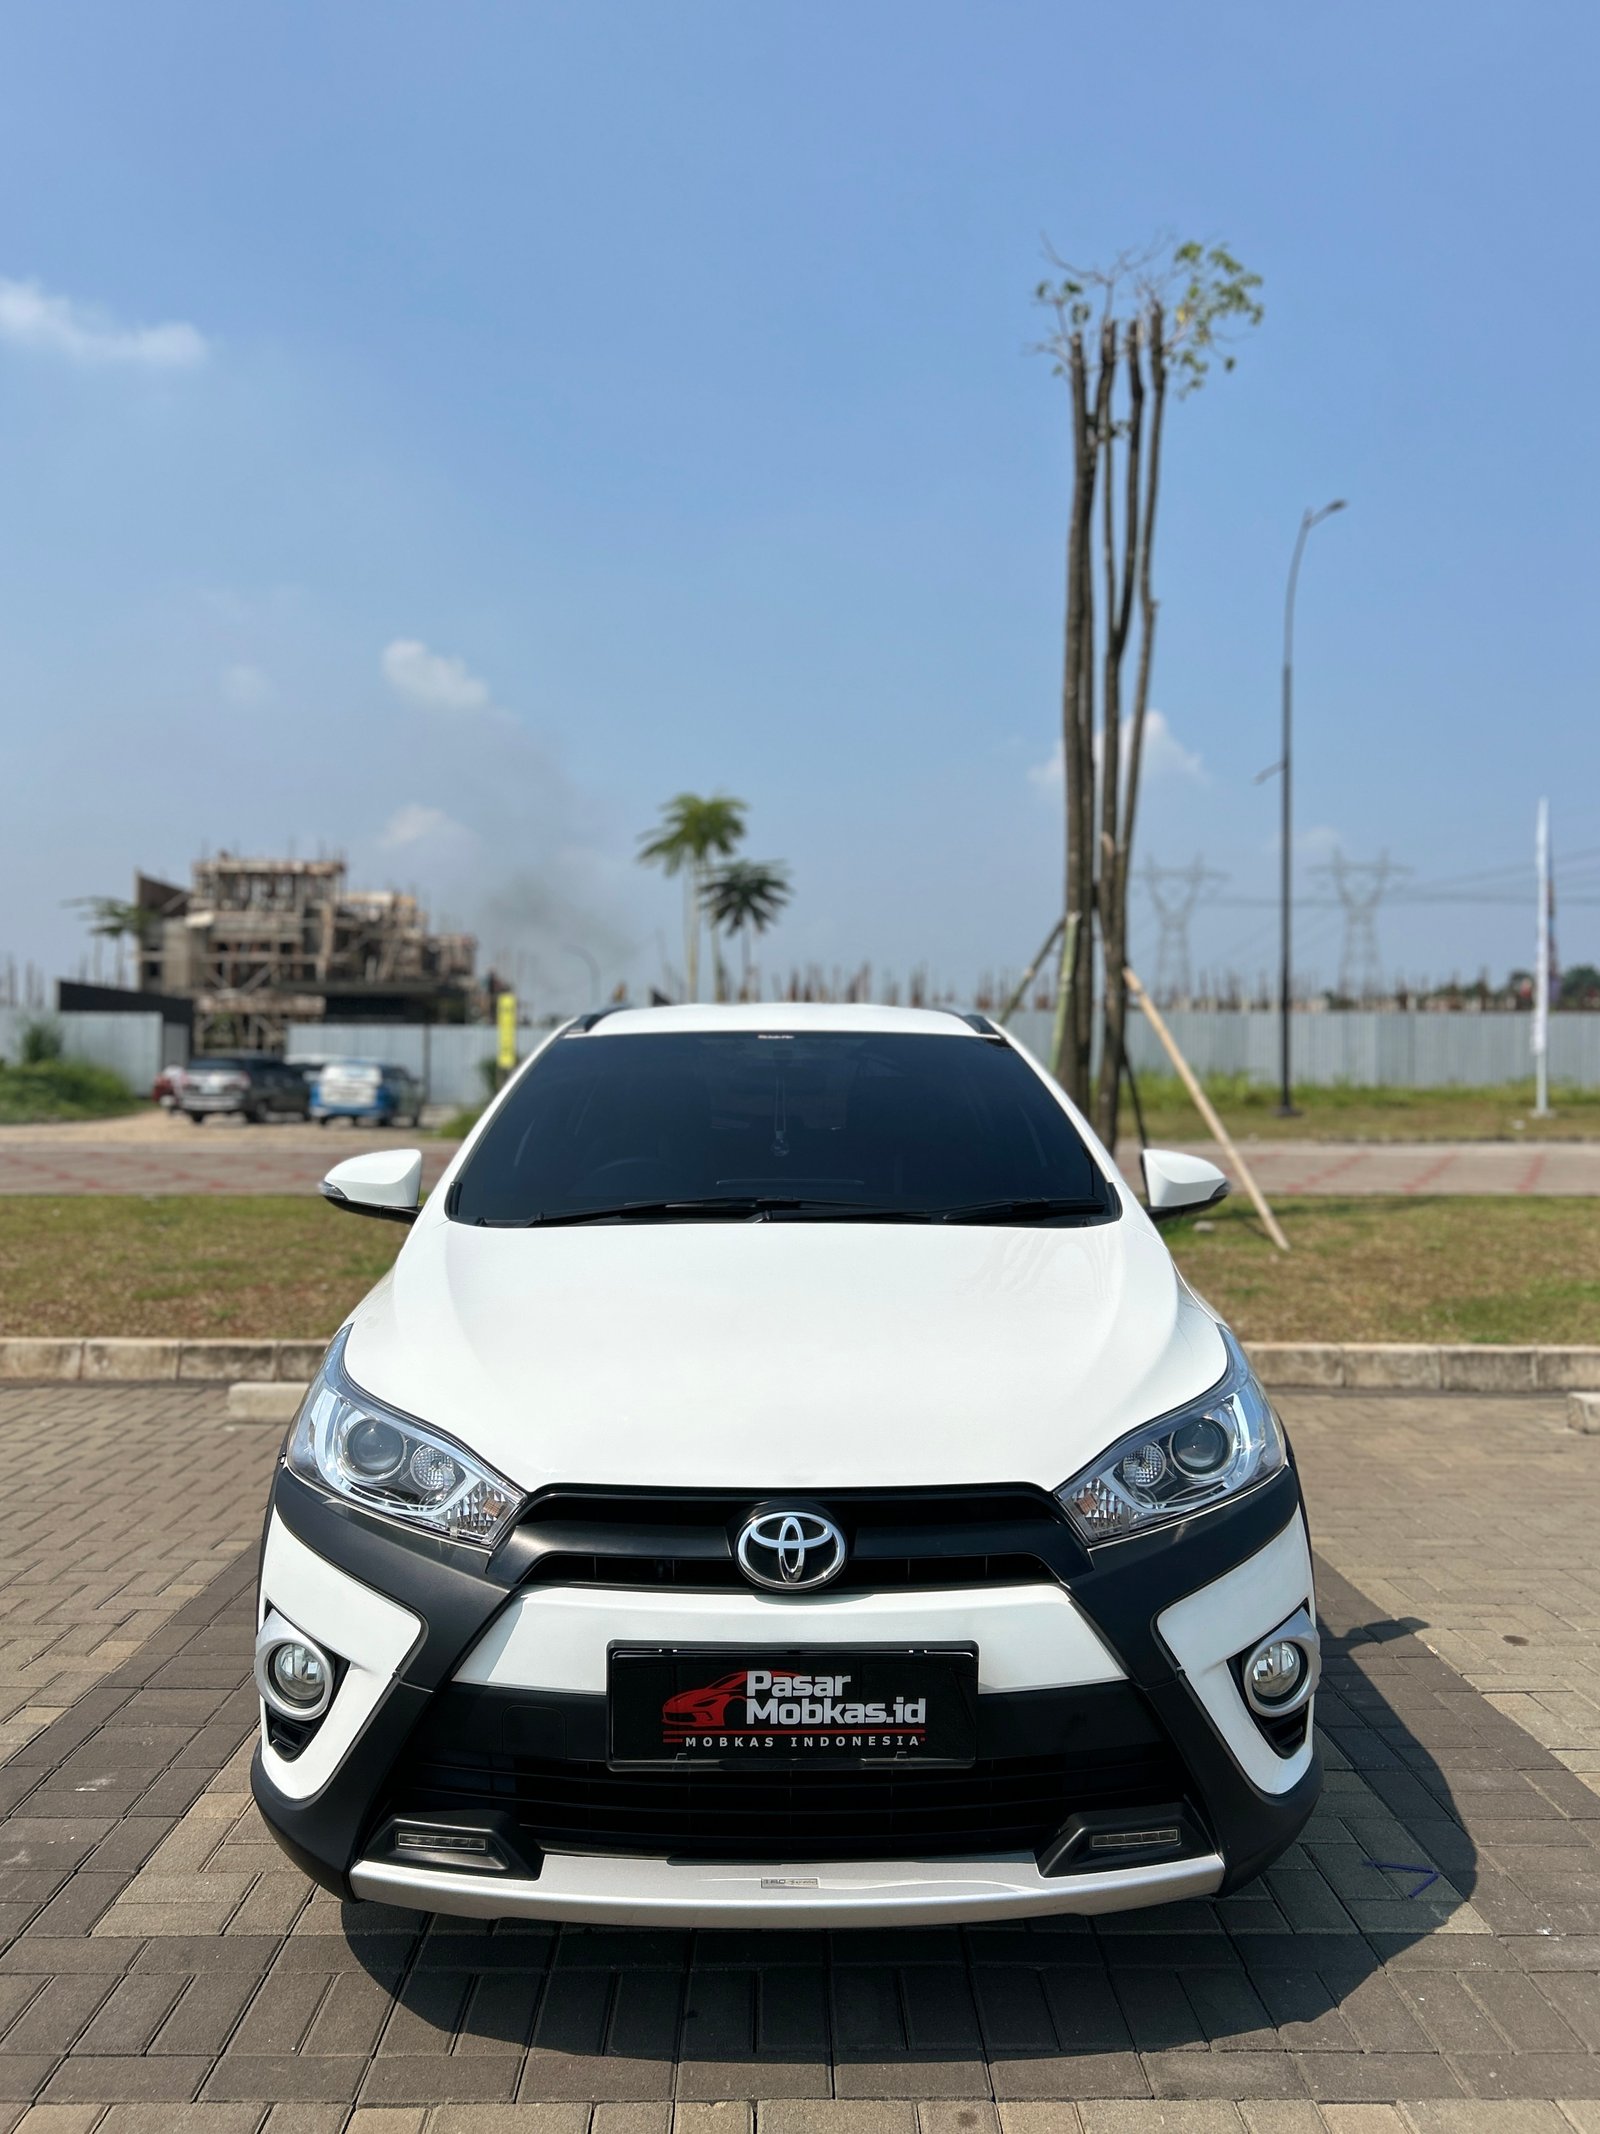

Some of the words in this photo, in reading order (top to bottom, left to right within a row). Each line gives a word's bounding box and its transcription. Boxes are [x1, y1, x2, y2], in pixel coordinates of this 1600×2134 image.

[746, 1670, 851, 1697] Pasar
[746, 1697, 926, 1724] Mobkas.id
[685, 1737, 774, 1747] MOBKAS
[791, 1736, 919, 1746] INDONESIA
